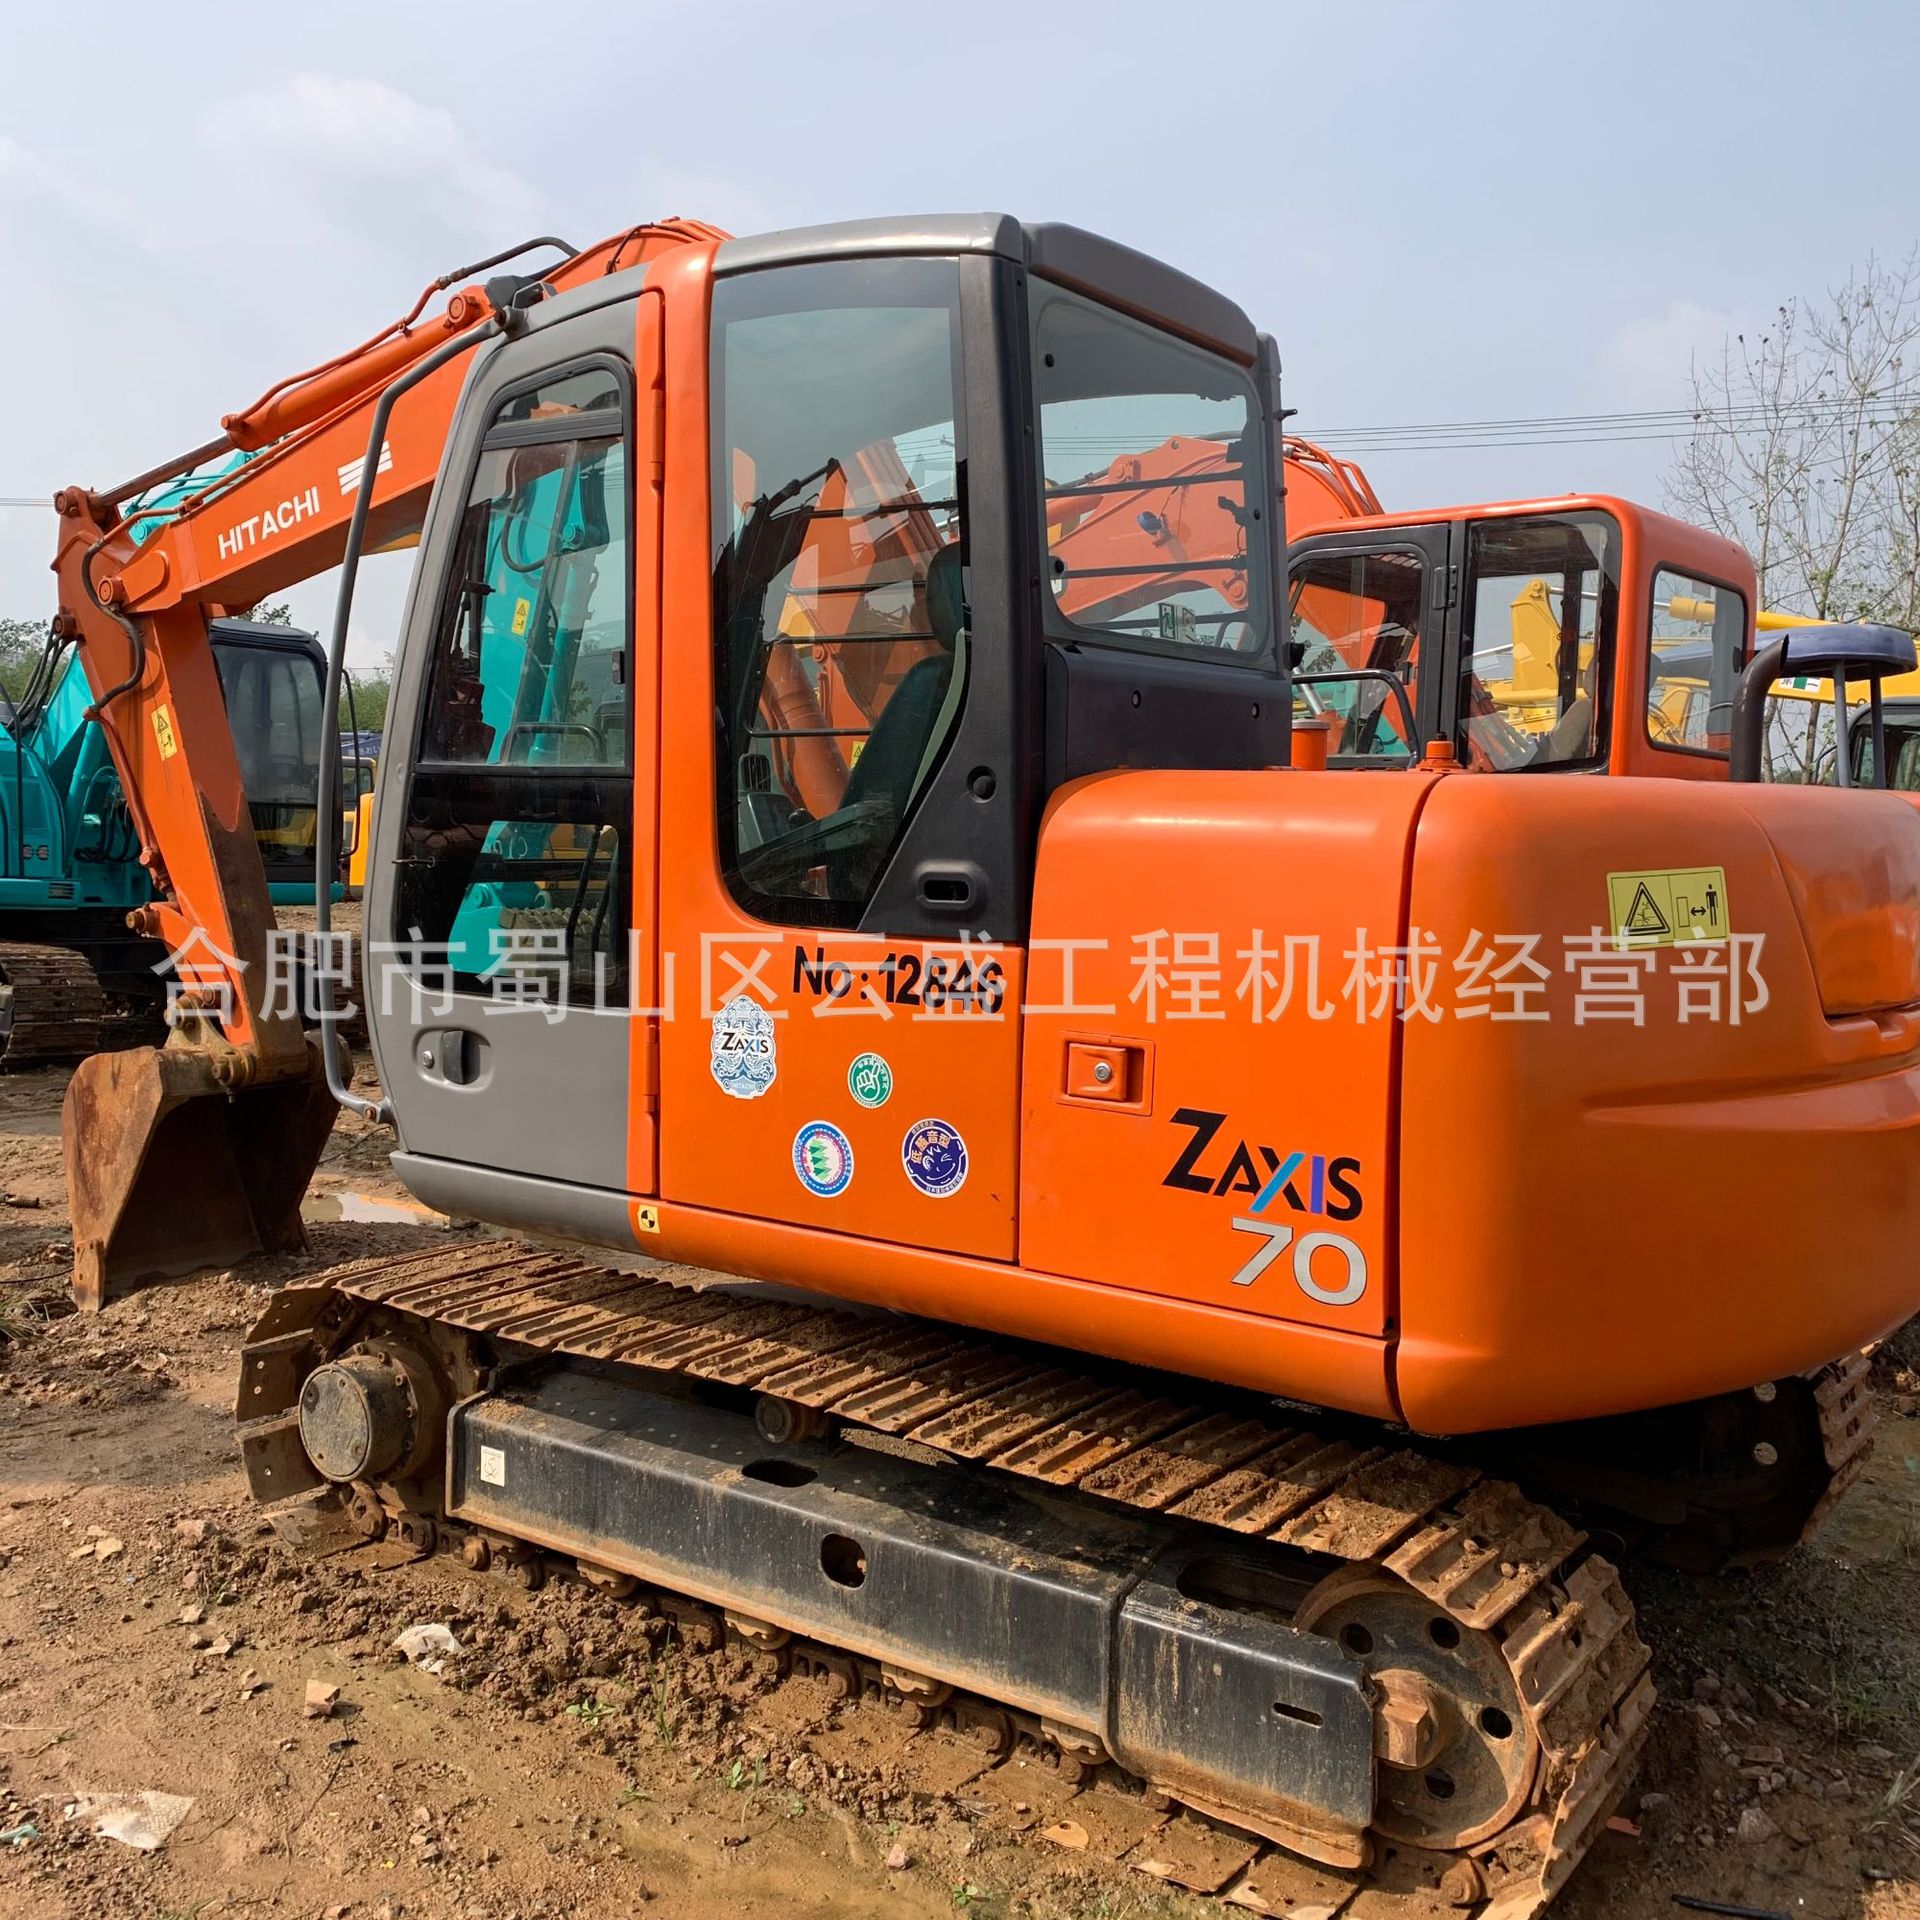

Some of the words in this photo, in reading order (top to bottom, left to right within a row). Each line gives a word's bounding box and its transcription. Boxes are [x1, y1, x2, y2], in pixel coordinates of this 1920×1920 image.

[217, 486, 320, 561] HITACHI
[721, 1032, 769, 1055] ZAXIS
[1161, 1107, 1363, 1222] ZAXIS
[1230, 1216, 1367, 1306] 70
